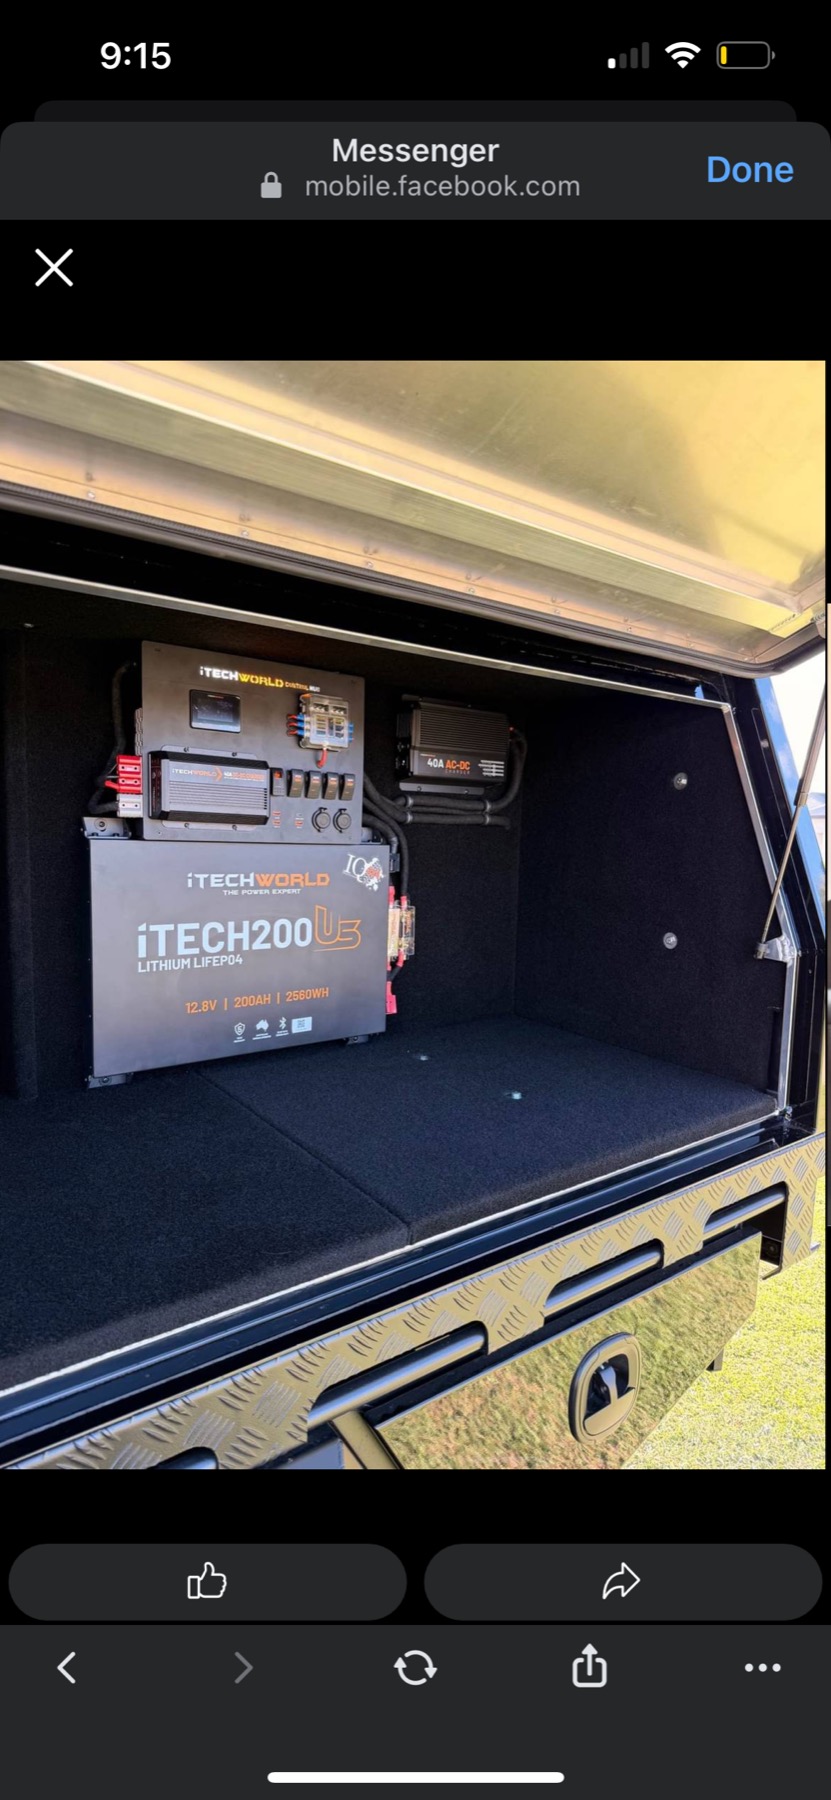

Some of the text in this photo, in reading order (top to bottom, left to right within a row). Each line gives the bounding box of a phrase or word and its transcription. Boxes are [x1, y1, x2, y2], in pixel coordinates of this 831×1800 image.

[199, 666, 284, 688] iTECHWORLD
[427, 758, 444, 768] 40A
[445, 759, 471, 770] AC-DC
[187, 871, 331, 889] iTECHWORLD
[241, 888, 270, 896] POWER
[137, 917, 313, 959] iTECH200
[137, 956, 191, 973] LITHIUM
[185, 986, 330, 1014] 12.8V 200AH 2560WH
